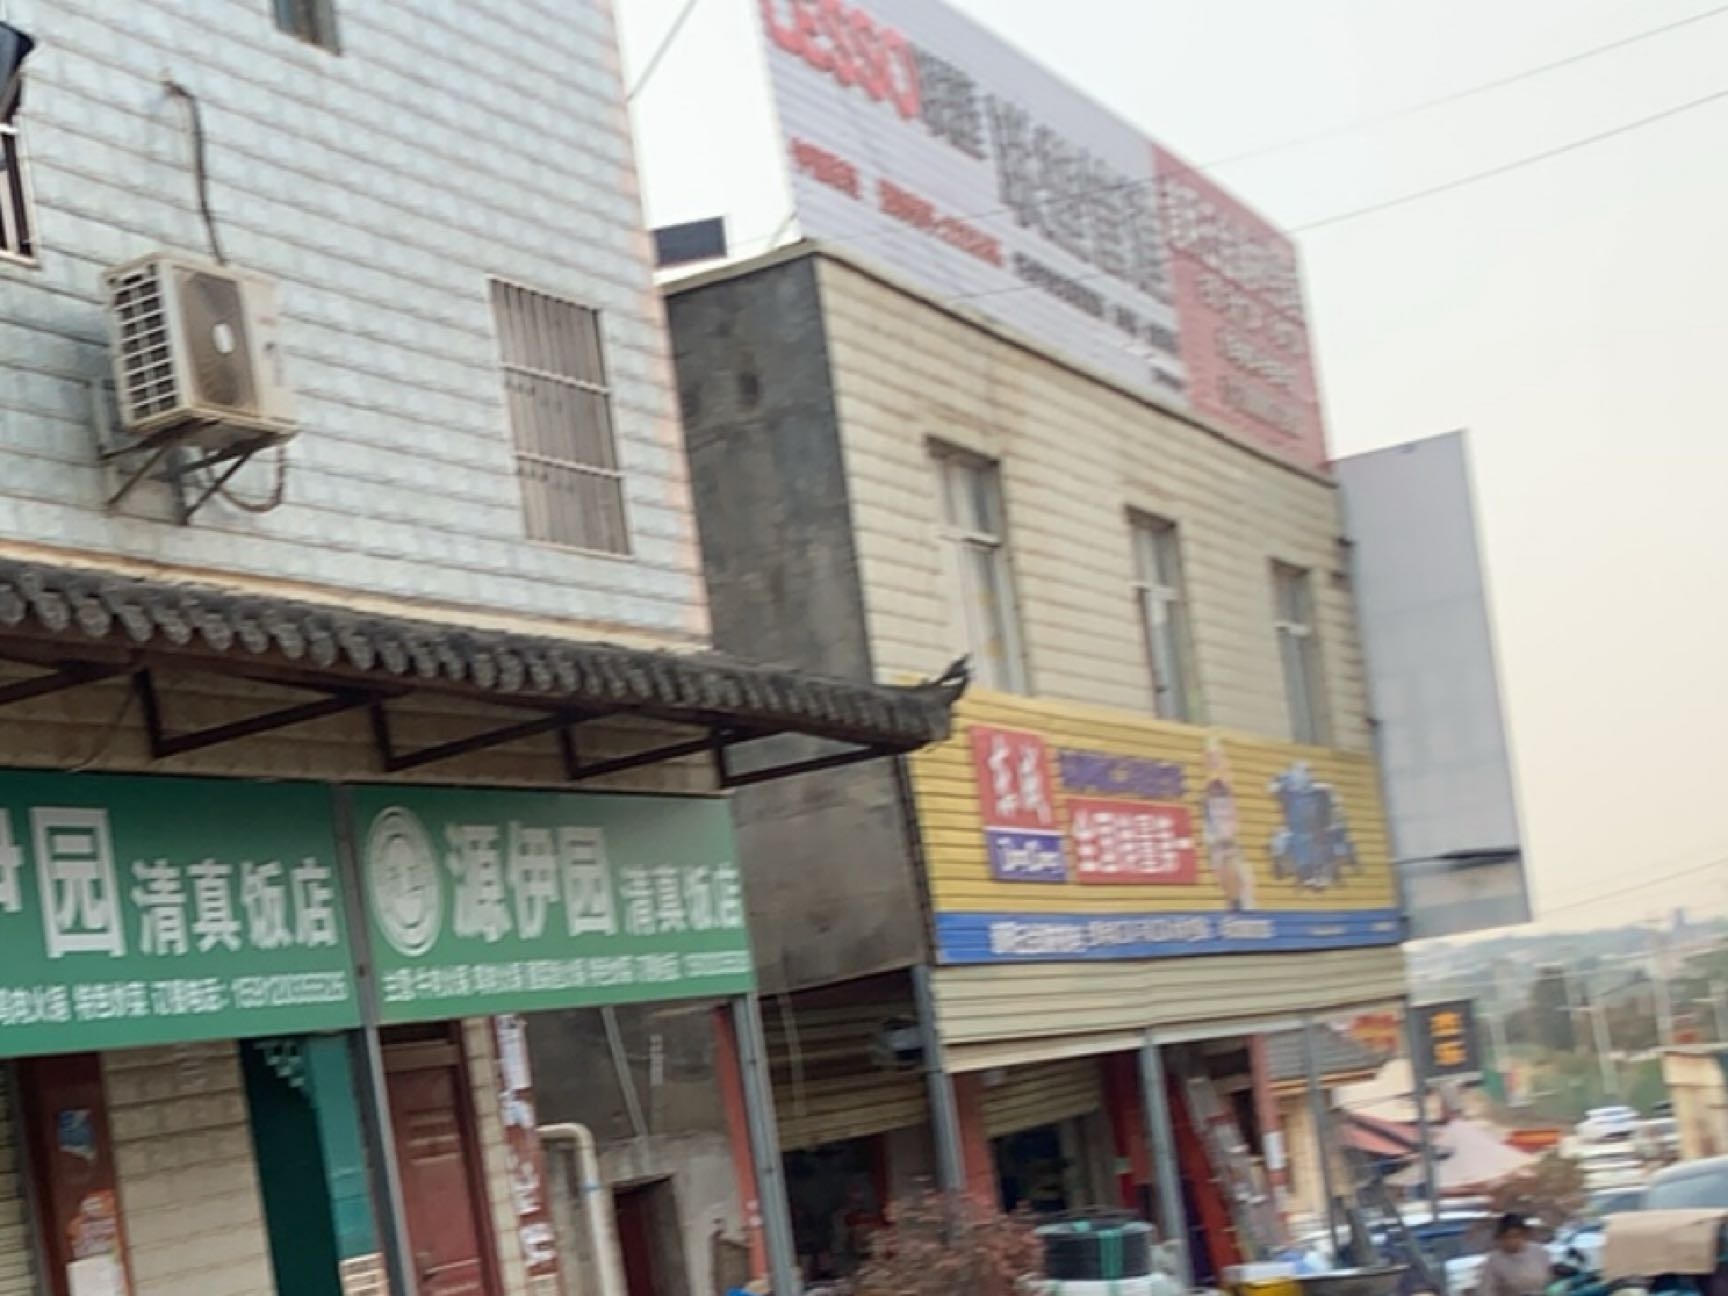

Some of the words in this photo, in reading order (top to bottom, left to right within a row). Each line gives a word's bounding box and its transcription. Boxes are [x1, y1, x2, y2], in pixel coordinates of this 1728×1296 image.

[130, 857, 339, 957] 清真饭店
[443, 819, 618, 943] 源伊园
